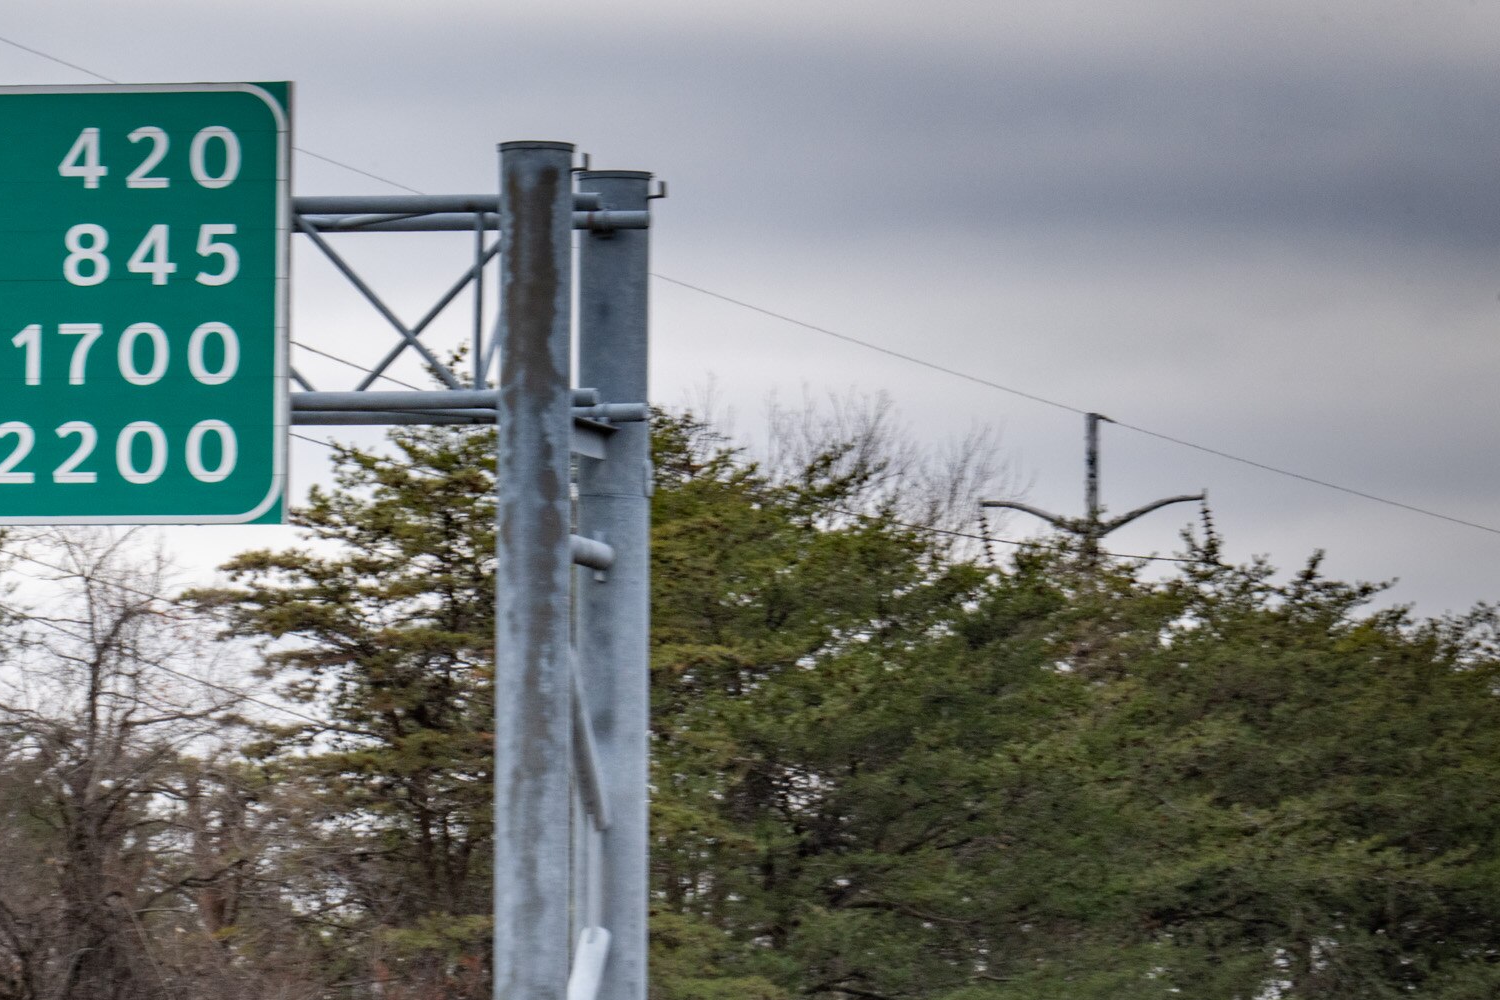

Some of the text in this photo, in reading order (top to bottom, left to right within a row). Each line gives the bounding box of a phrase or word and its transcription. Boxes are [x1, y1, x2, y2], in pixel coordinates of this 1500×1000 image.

[59, 126, 240, 190] 420
[64, 223, 239, 287] 845
[13, 322, 240, 386] 1700
